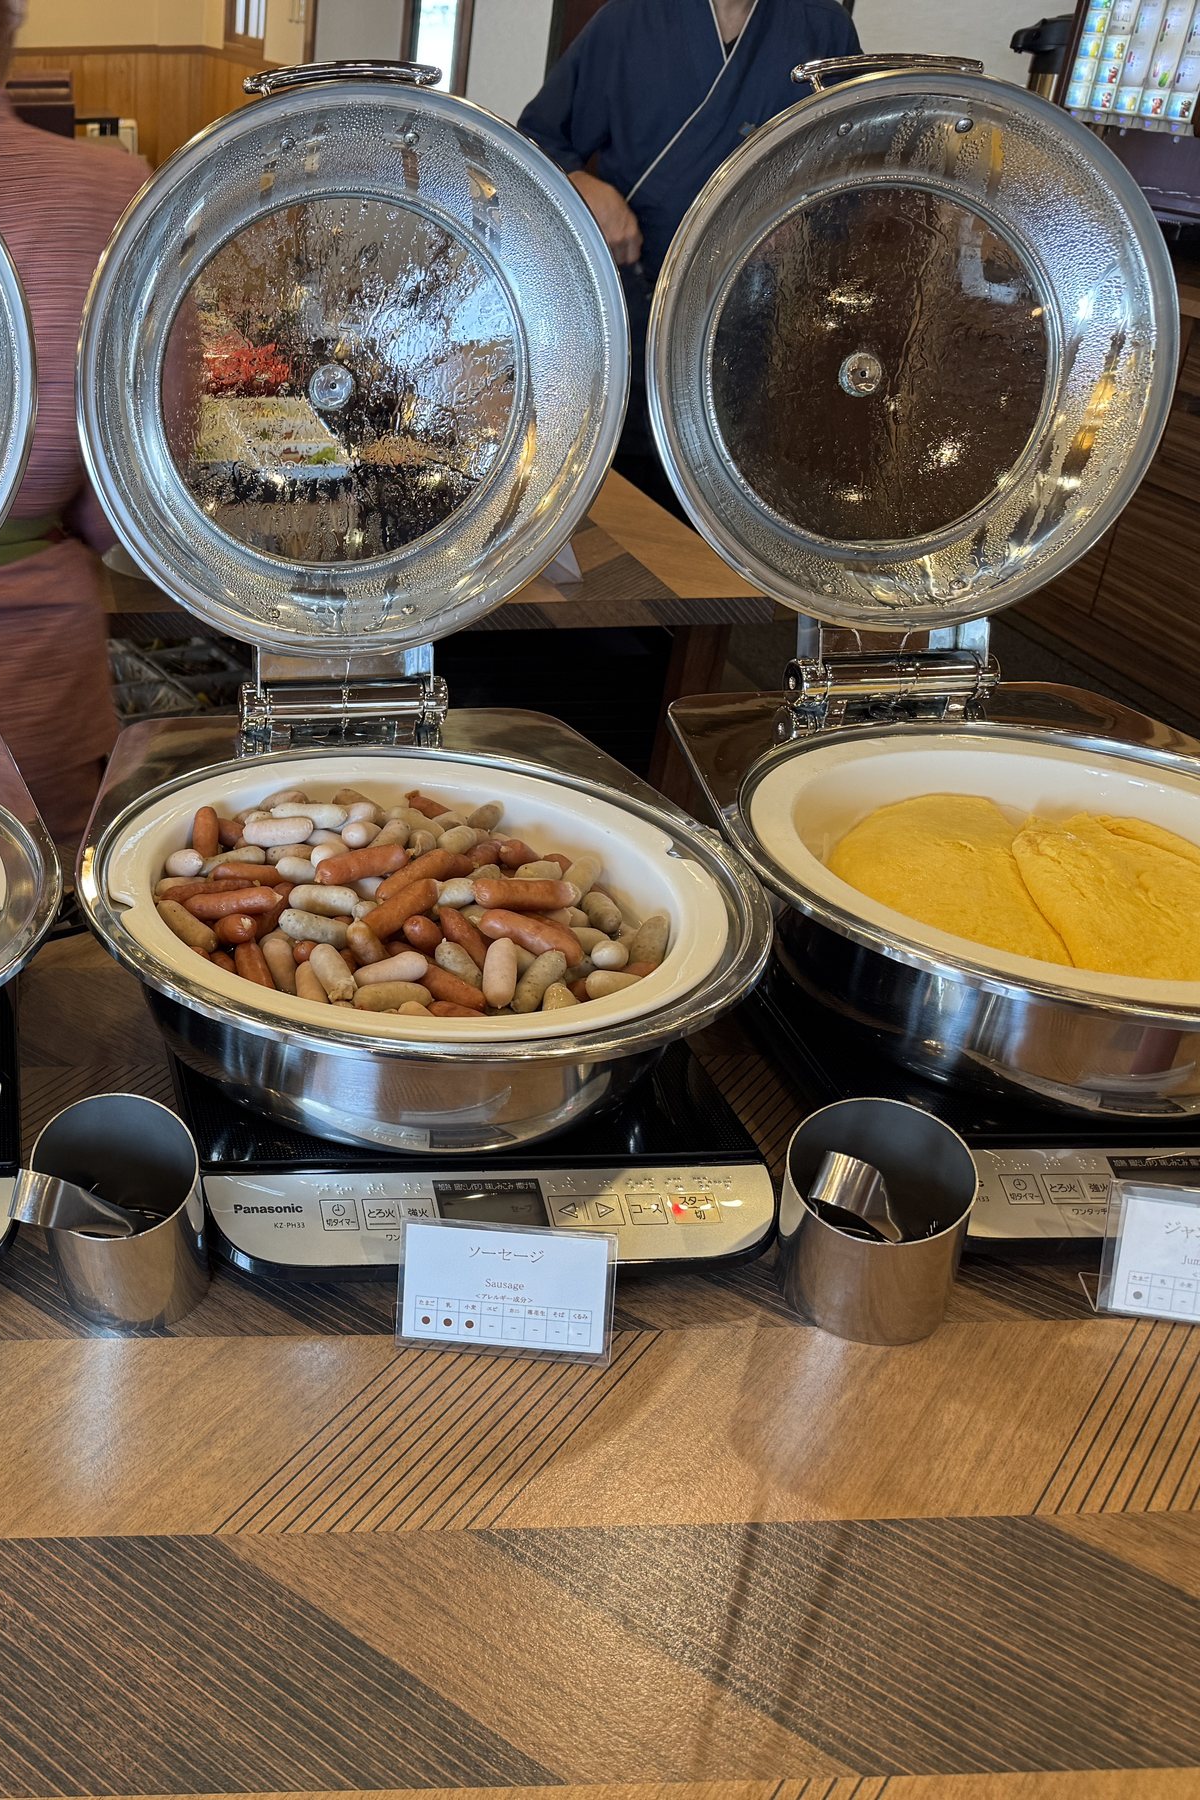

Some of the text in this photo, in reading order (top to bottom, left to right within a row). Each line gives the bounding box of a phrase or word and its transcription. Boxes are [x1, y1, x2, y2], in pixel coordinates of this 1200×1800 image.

[1049, 1183, 1109, 1193] とろ火 強火
[678, 1196, 713, 1206] スタート
[1009, 1192, 1040, 1201] 切タイマー
[233, 1203, 303, 1214] Panasonic
[367, 1207, 429, 1218] とろ火 強火
[630, 1203, 663, 1214] コース
[694, 1210, 706, 1220] 切
[274, 1221, 305, 1229] KZ-PH33
[326, 1218, 356, 1227] 切タイマー
[468, 1246, 545, 1264] ソーセージ
[484, 1278, 525, 1291] Sausage
